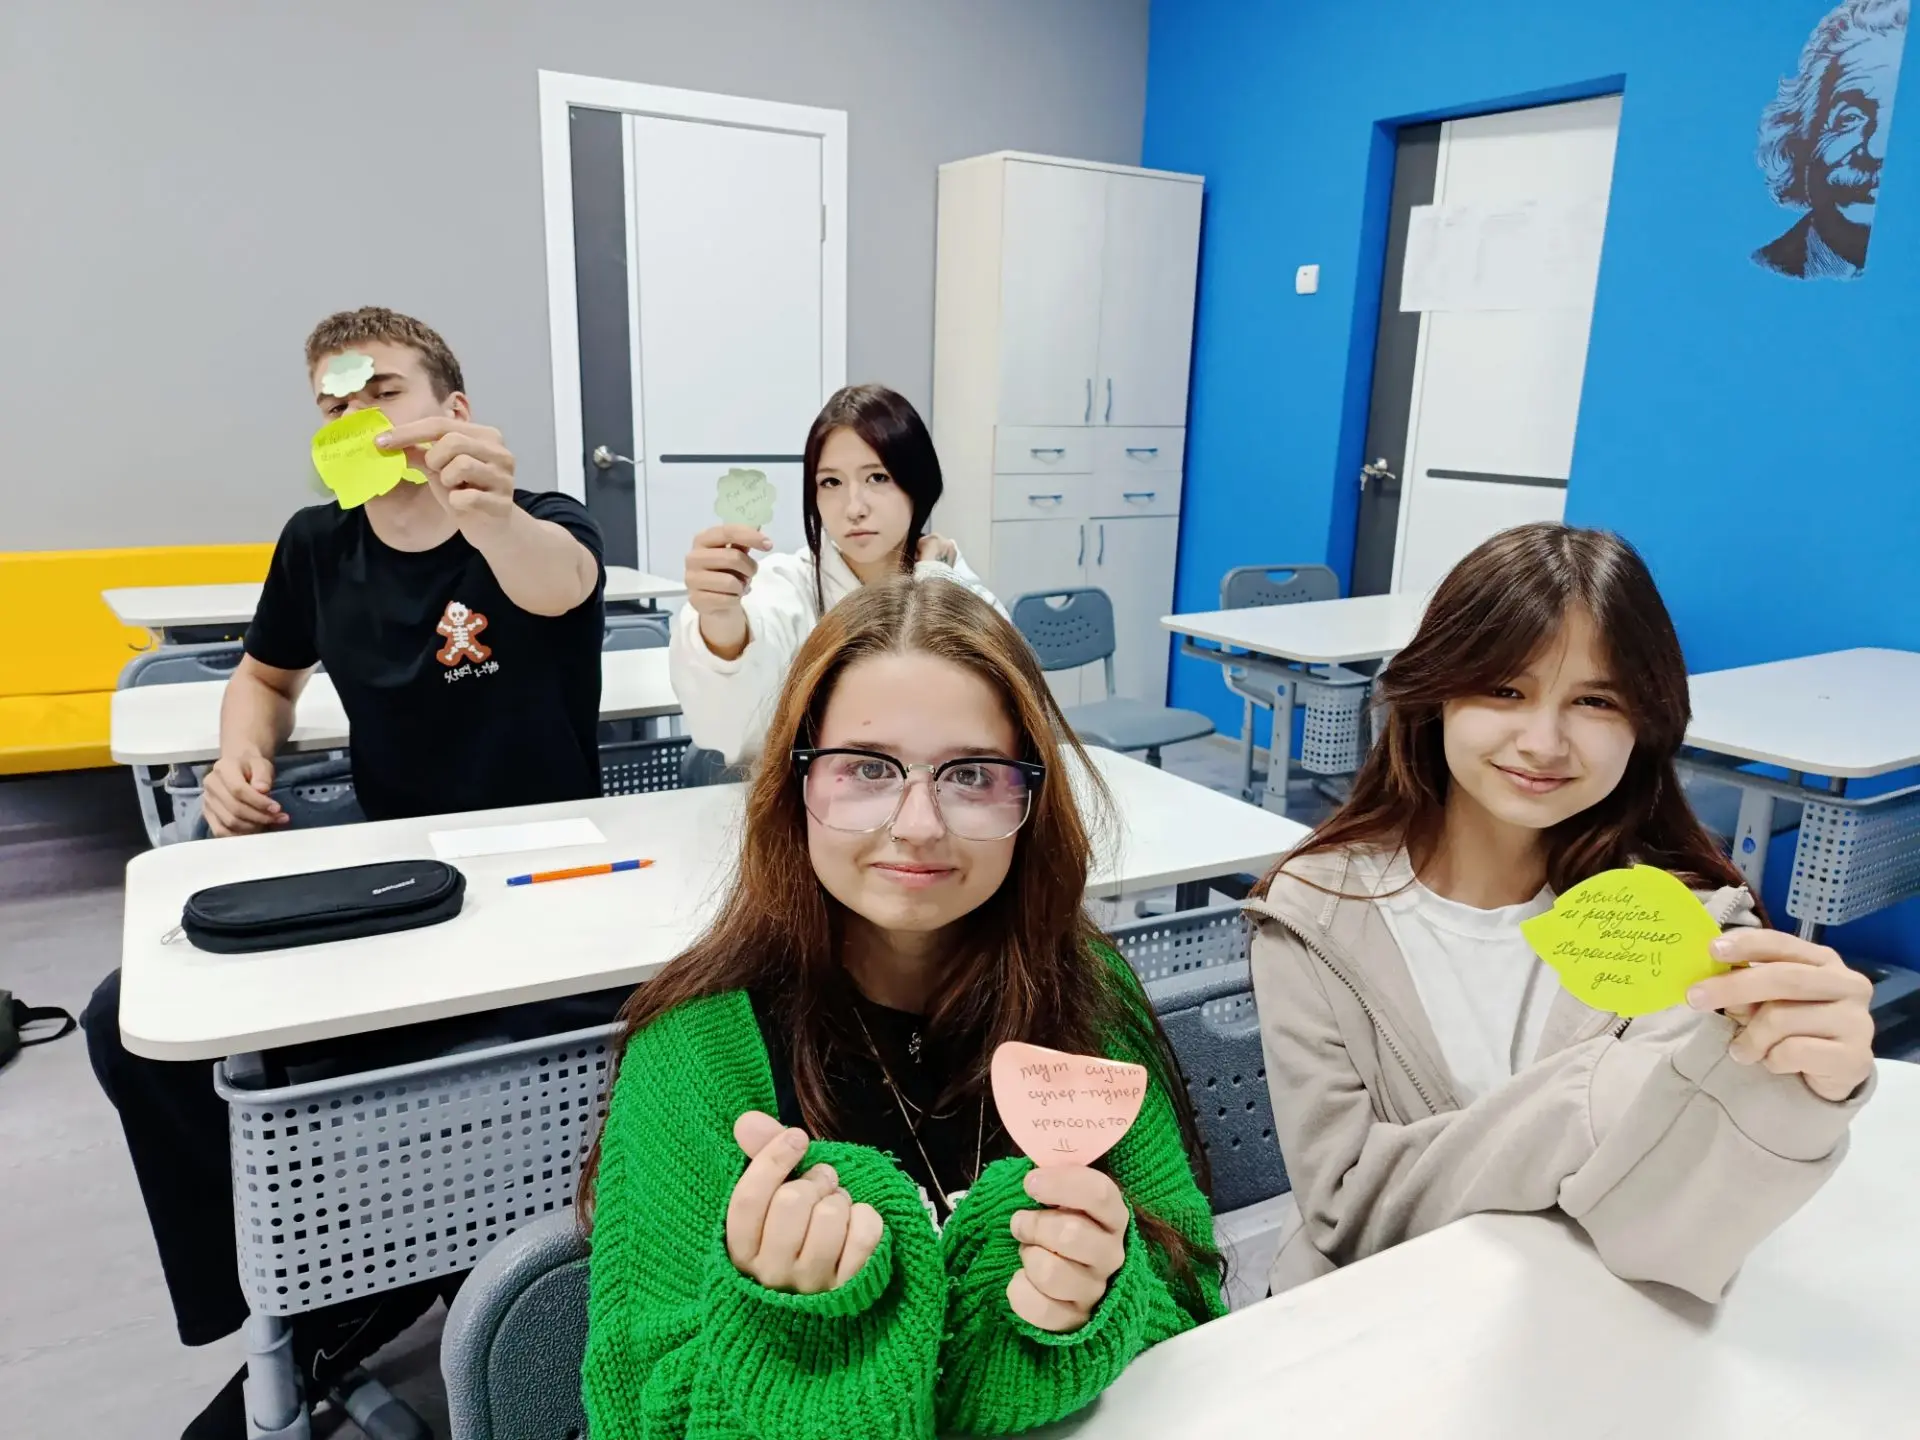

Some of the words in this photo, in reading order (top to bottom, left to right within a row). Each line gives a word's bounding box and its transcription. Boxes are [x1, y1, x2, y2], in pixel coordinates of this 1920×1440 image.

[1560, 909, 1579, 919] и
[1577, 904, 1665, 930] радуйся
[1599, 928, 1683, 950] жизнью
[1590, 971, 1635, 989] дня
[1085, 1064, 1141, 1084] сидит
